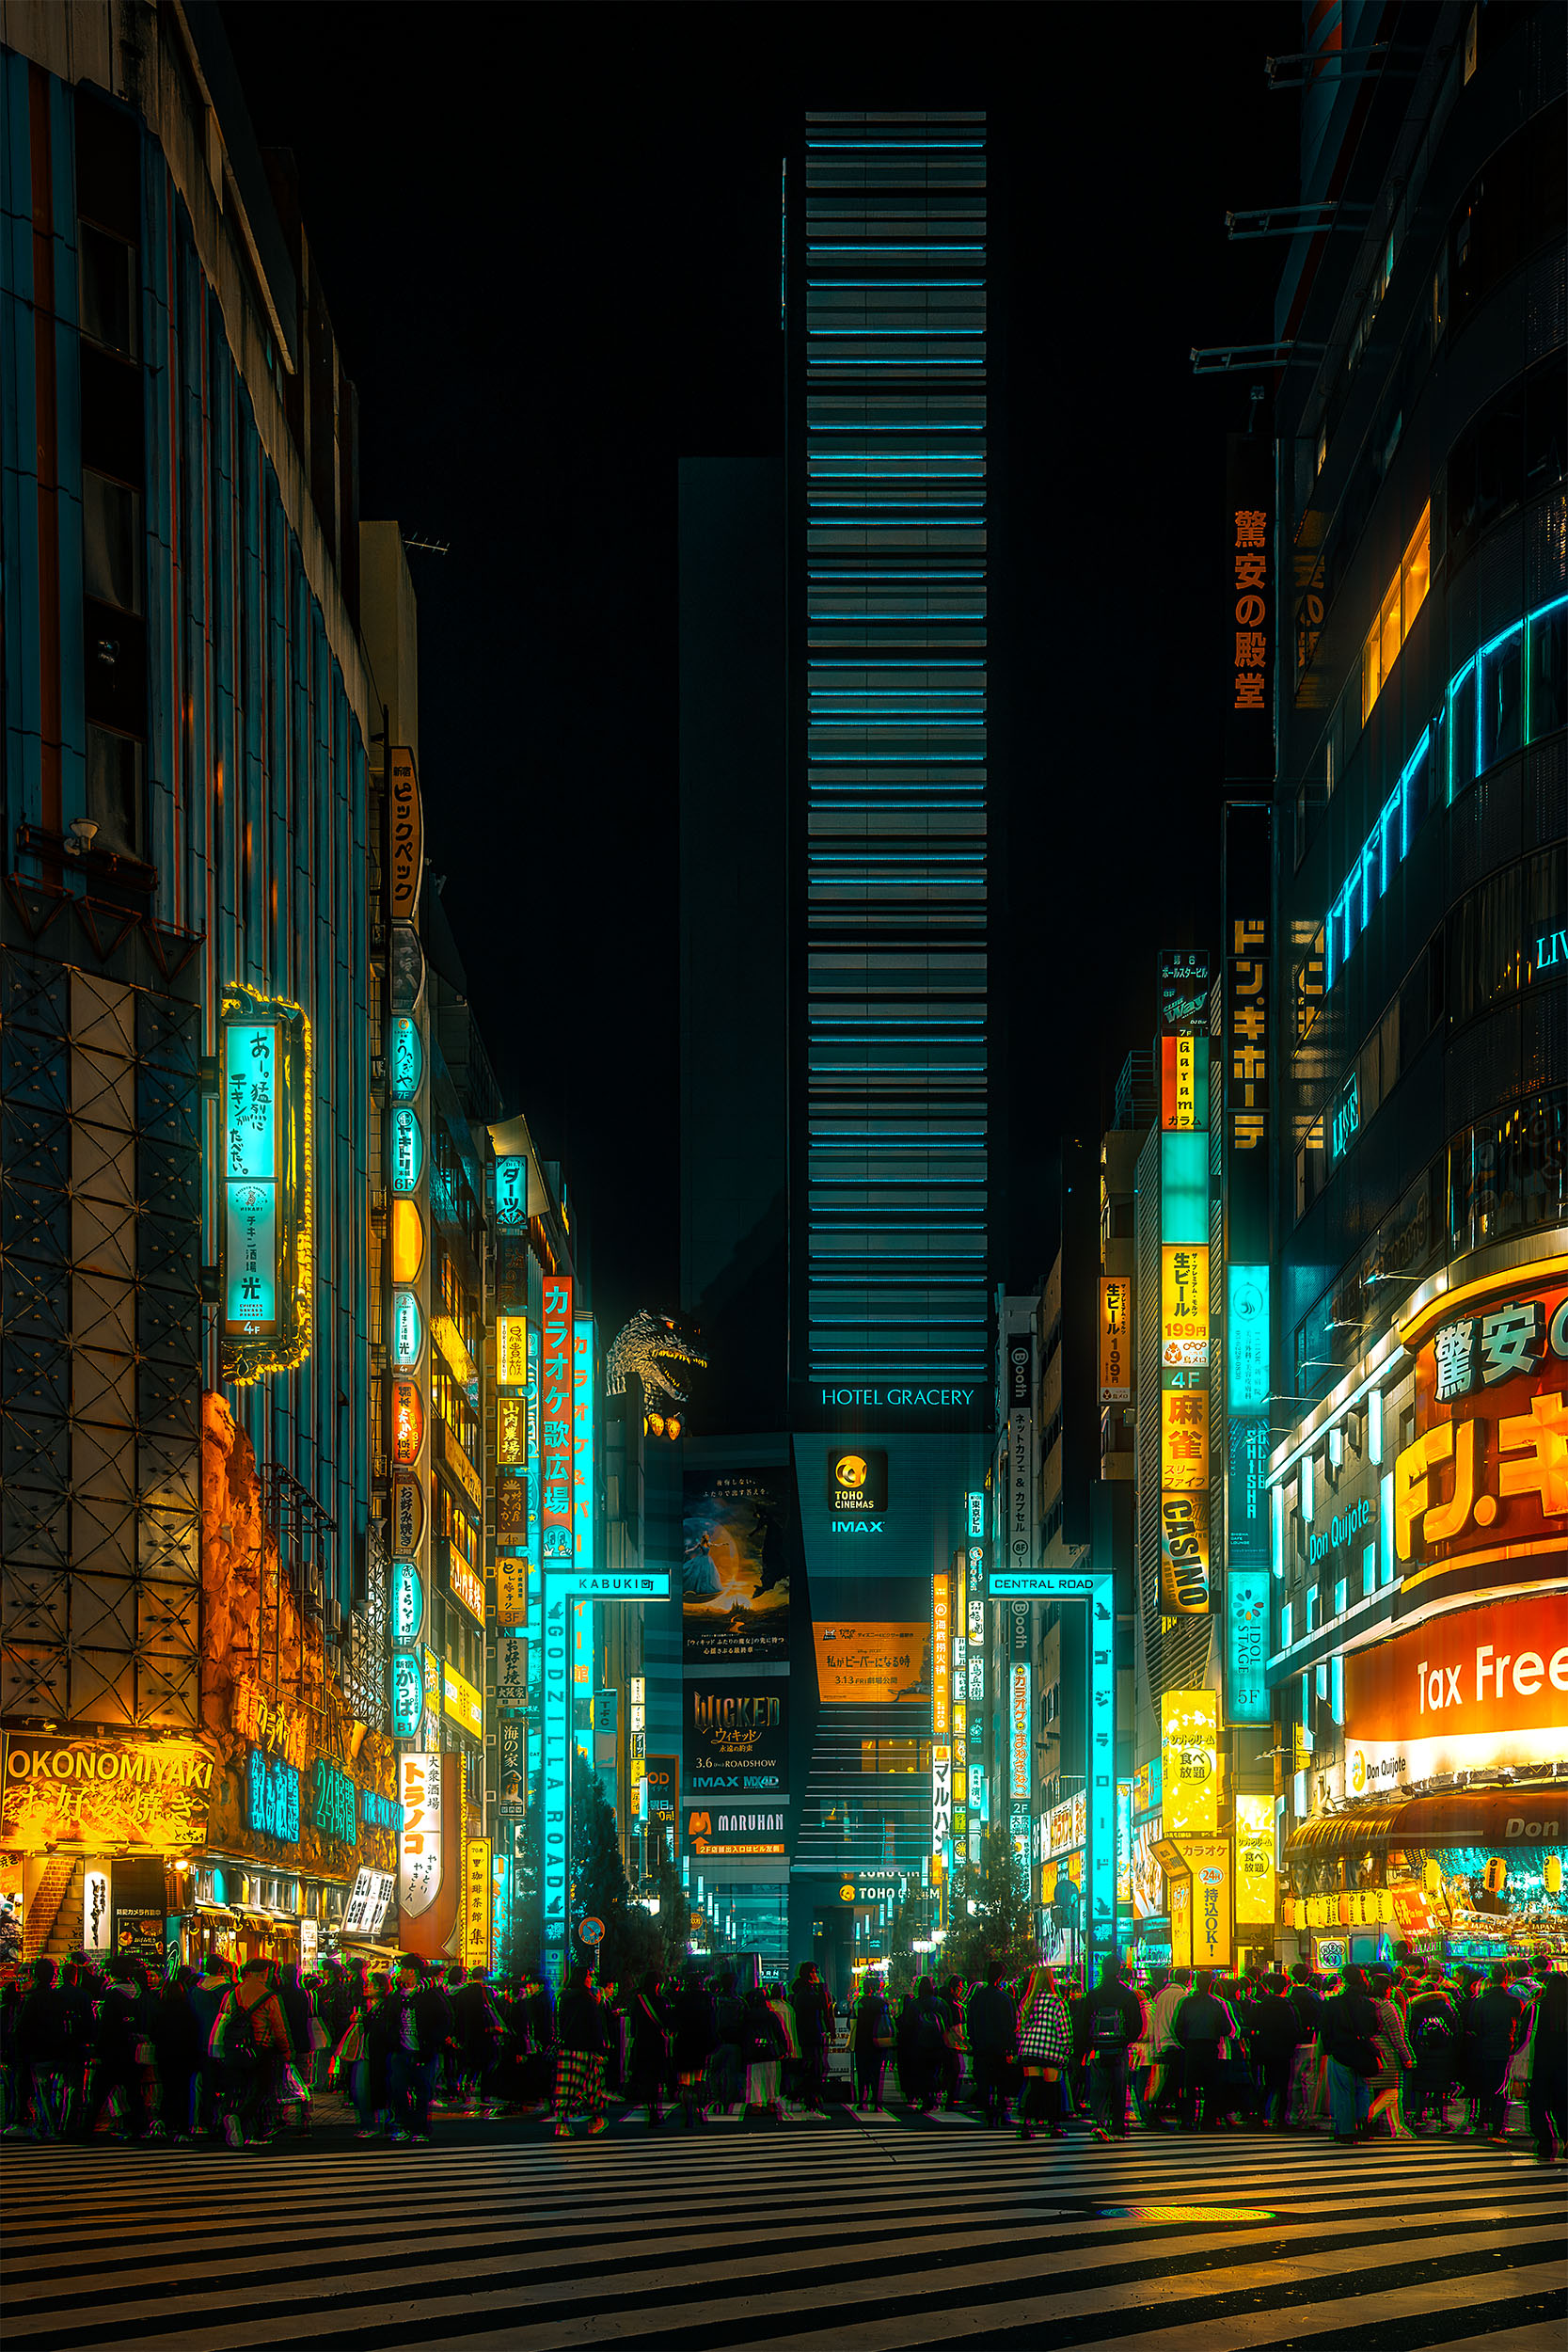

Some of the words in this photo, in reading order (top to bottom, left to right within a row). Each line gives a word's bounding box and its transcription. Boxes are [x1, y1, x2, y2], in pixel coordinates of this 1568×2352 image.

[1235, 511, 1266, 708] 驚安の殿堂
[397, 1091, 410, 1100] 7F
[1168, 1116, 1202, 1126] ガラム
[395, 1178, 415, 1190] 6F
[503, 1168, 520, 1214] ダーツ
[242, 1277, 261, 1299] 光
[1174, 1253, 1190, 1317] 生ビール
[1106, 1283, 1120, 1335] 生ビール
[244, 1321, 261, 1334] 4F
[1165, 1324, 1207, 1337] 199円
[399, 1342, 410, 1355] 光
[1011, 1347, 1029, 1398] Booth
[1171, 1372, 1199, 1388] 4F
[544, 1286, 570, 1515] カラオケ歌広場
[822, 1390, 883, 1406] HOTEL
[887, 1390, 974, 1406] GRACERY
[502, 1400, 521, 1455] 山内農場
[1168, 1395, 1204, 1459] 麻雀
[1015, 1414, 1026, 1473] ネットカフェ
[1164, 1465, 1196, 1475] スリー
[835, 1490, 863, 1500] TOHO
[835, 1500, 875, 1509] CINEMAS
[400, 1486, 414, 1548] お好み焼き
[832, 1521, 884, 1533] IMAX
[972, 1500, 981, 1534] 東京ビル
[504, 1536, 519, 1545] 4F
[1309, 1534, 1329, 1565] Don
[1331, 1498, 1370, 1549] Quijote
[1163, 1499, 1210, 1607] CASINO
[994, 1580, 1054, 1589] CENTRAL
[1058, 1580, 1094, 1589] ROAD
[504, 1613, 520, 1624] 3F
[1011, 1599, 1029, 1649] Booth
[398, 1636, 412, 1645] 1F
[1238, 1626, 1249, 1674] STAGE
[1250, 1626, 1261, 1665] IDOL
[827, 1654, 911, 1668] 私がビーバーになる時
[1417, 1660, 1464, 1715] Tax
[1476, 1643, 1568, 1702] Free
[395, 1669, 415, 1717] かっぱ
[1015, 1676, 1027, 1721] カラオケ
[1238, 1690, 1260, 1704] 5F
[547, 1626, 564, 1790] GODZILLA
[694, 1692, 781, 1734] WICKED
[397, 1722, 413, 1732] B1
[713, 1728, 760, 1743] ウィキッド
[503, 1725, 519, 1767] 海の家
[8, 1750, 214, 1789] OKONOMIYAKI
[696, 1757, 713, 1768] 3.6
[1014, 1732, 1027, 1798] まねきねこ
[1094, 1649, 1112, 1870] ゴジラロード
[1180, 1752, 1205, 1765] 食べ
[1367, 1764, 1380, 1779] Don
[1381, 1756, 1406, 1777] Quijote
[427, 1756, 440, 1811] 大衆酒場
[693, 1775, 739, 1788] IMAX
[1180, 1766, 1205, 1779] 放題
[19, 1784, 195, 1826] お好み焼き
[404, 1762, 425, 1854] トラノコ
[1013, 1804, 1028, 1814] 2F
[718, 1814, 784, 1831] MARUHAN
[1505, 1818, 1560, 1837] Don
[547, 1810, 564, 1888] ROAD
[1182, 1845, 1227, 1857] カラオケ
[1244, 1852, 1264, 1862] 食べ
[420, 1854, 437, 1894] やきとり
[1244, 1864, 1264, 1873] 放題
[859, 1888, 895, 1899] TOHO
[1204, 1888, 1219, 1957] 持込OK!
